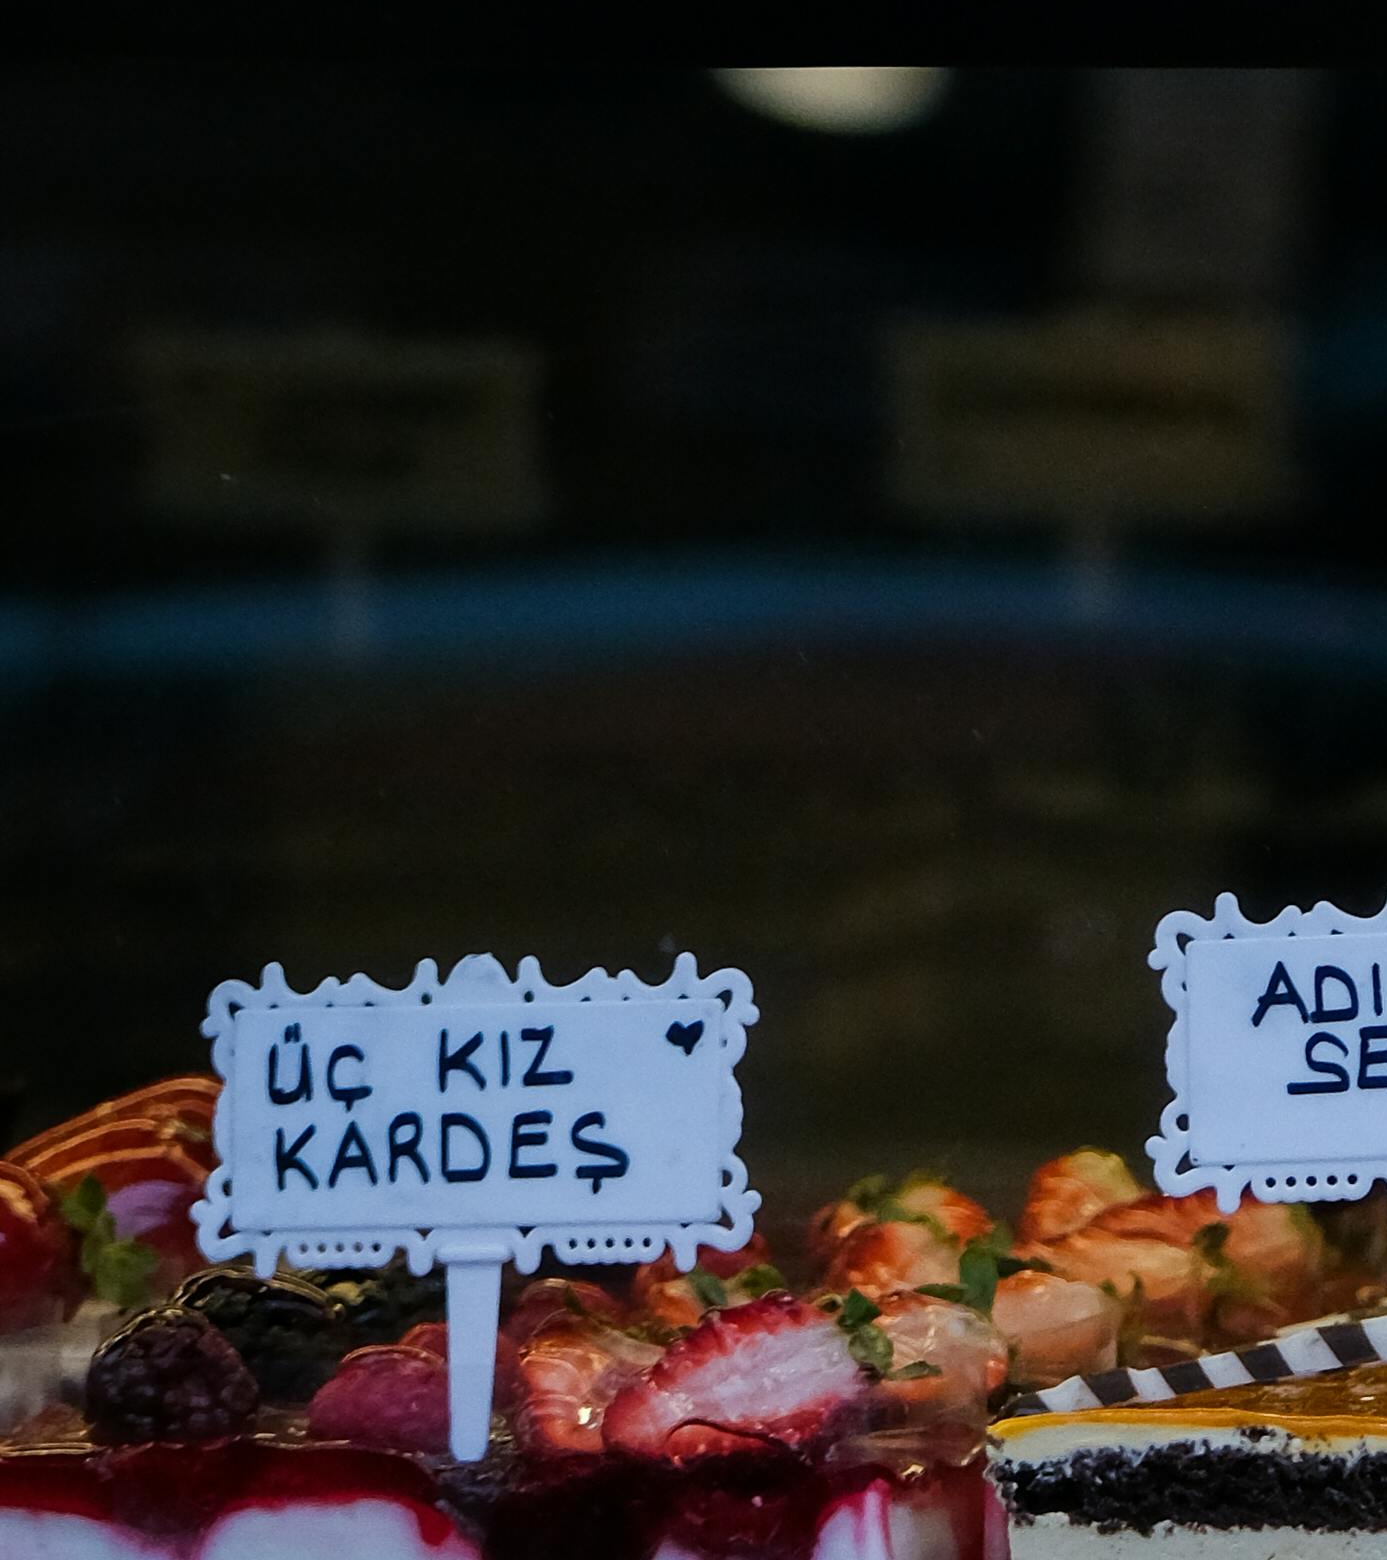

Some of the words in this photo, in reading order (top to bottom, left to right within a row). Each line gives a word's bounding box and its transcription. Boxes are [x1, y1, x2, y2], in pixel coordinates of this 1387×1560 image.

[1251, 961, 1384, 1027] ADI
[268, 1023, 372, 1110] ÜÇ
[438, 1025, 573, 1093] KIZ
[275, 1111, 629, 1194] KARDEŞ
